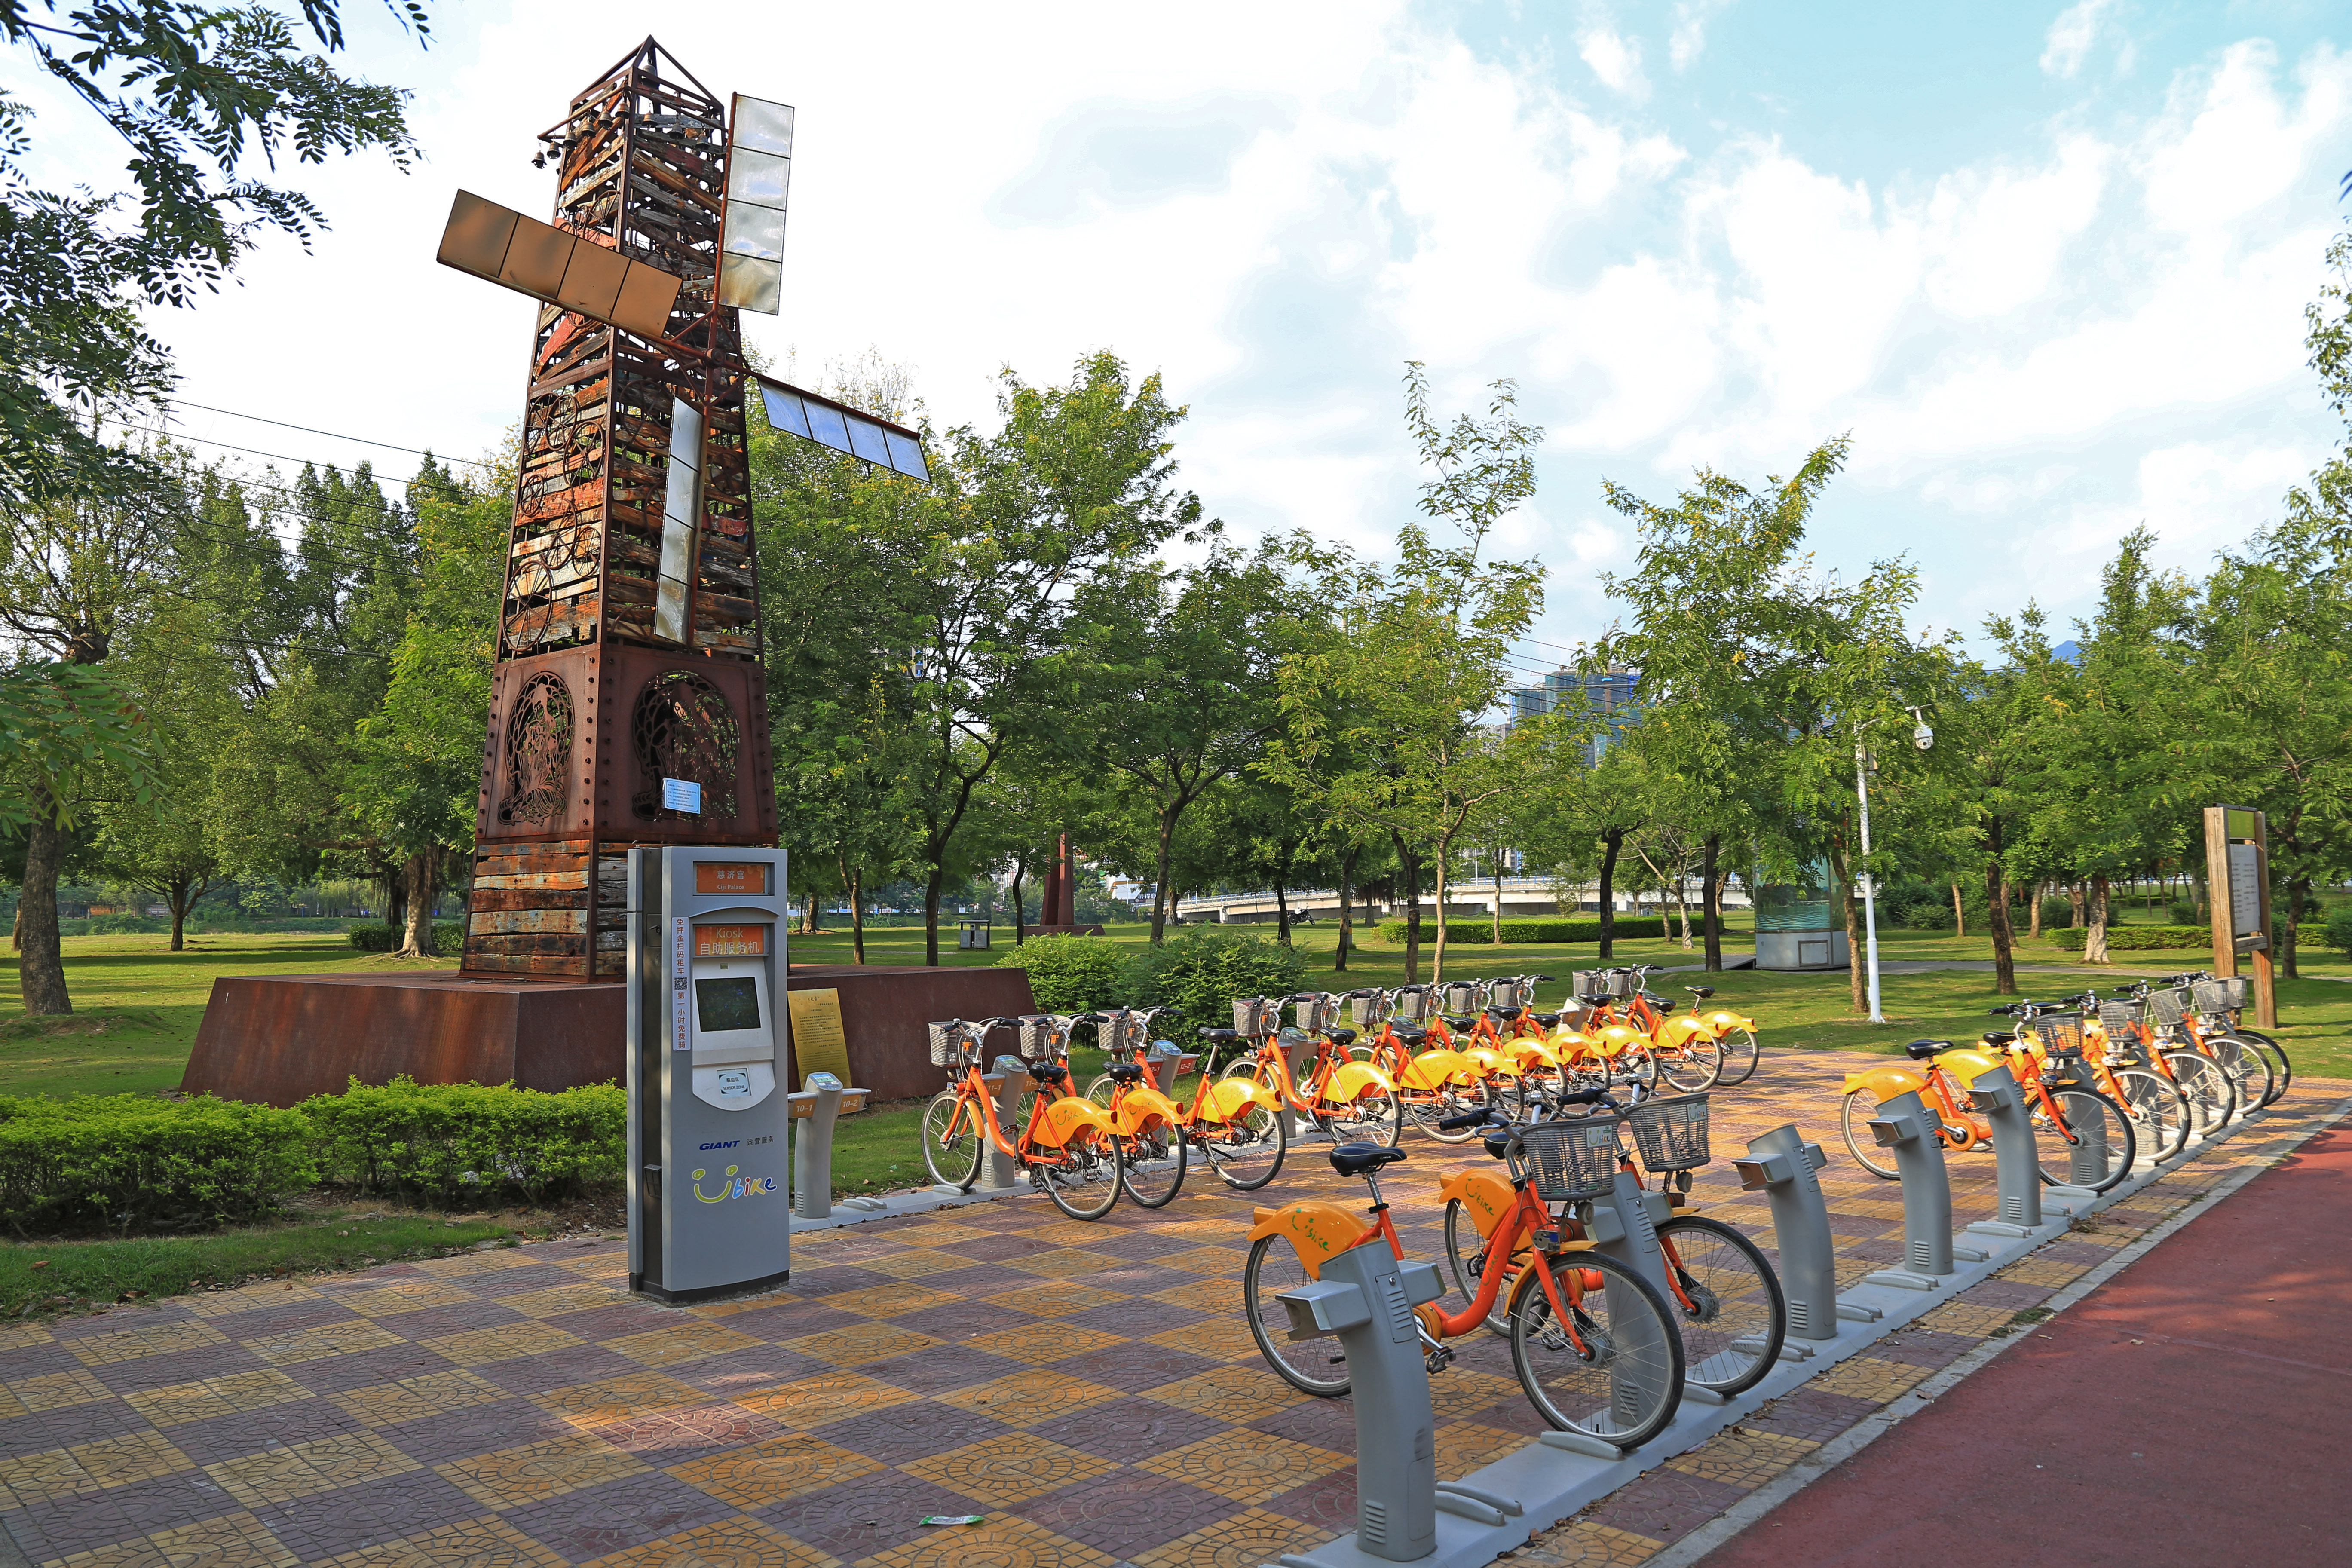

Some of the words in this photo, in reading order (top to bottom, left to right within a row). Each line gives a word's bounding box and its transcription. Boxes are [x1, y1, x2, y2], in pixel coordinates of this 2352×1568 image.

[717, 870, 744, 879] 慈济宫
[716, 927, 744, 938] Kiosk
[700, 941, 759, 955] 自助服务机
[677, 992, 686, 1049] 第一小时免费骑
[699, 1140, 740, 1150] GIANT
[747, 1136, 774, 1146] 运营服务
